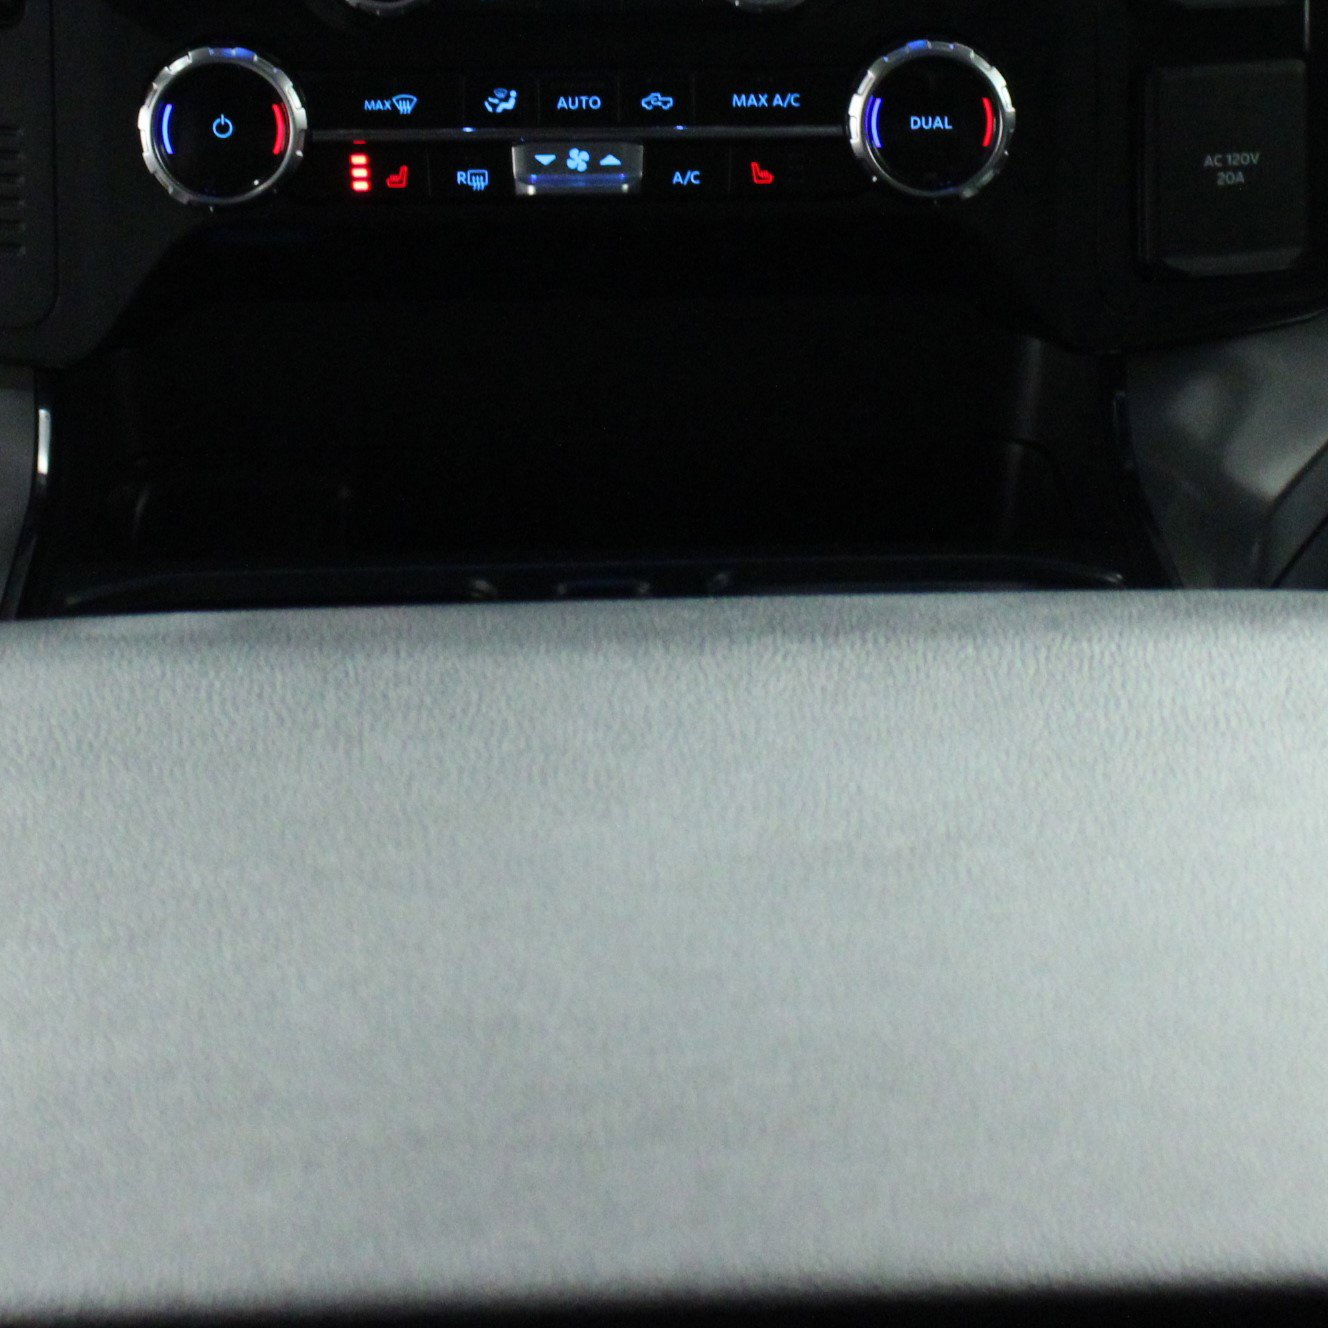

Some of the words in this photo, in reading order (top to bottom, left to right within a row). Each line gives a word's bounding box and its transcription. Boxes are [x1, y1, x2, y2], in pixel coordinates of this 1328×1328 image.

[364, 97, 394, 111] MAX
[556, 95, 602, 110] AUTO
[732, 93, 769, 108] MAX
[772, 92, 800, 108] A/C
[910, 115, 953, 130] DUAL
[1203, 154, 1223, 168] AC
[1225, 151, 1260, 166] 120V
[456, 170, 467, 185] R
[672, 170, 701, 186] A/C
[1216, 170, 1245, 186] 20A
